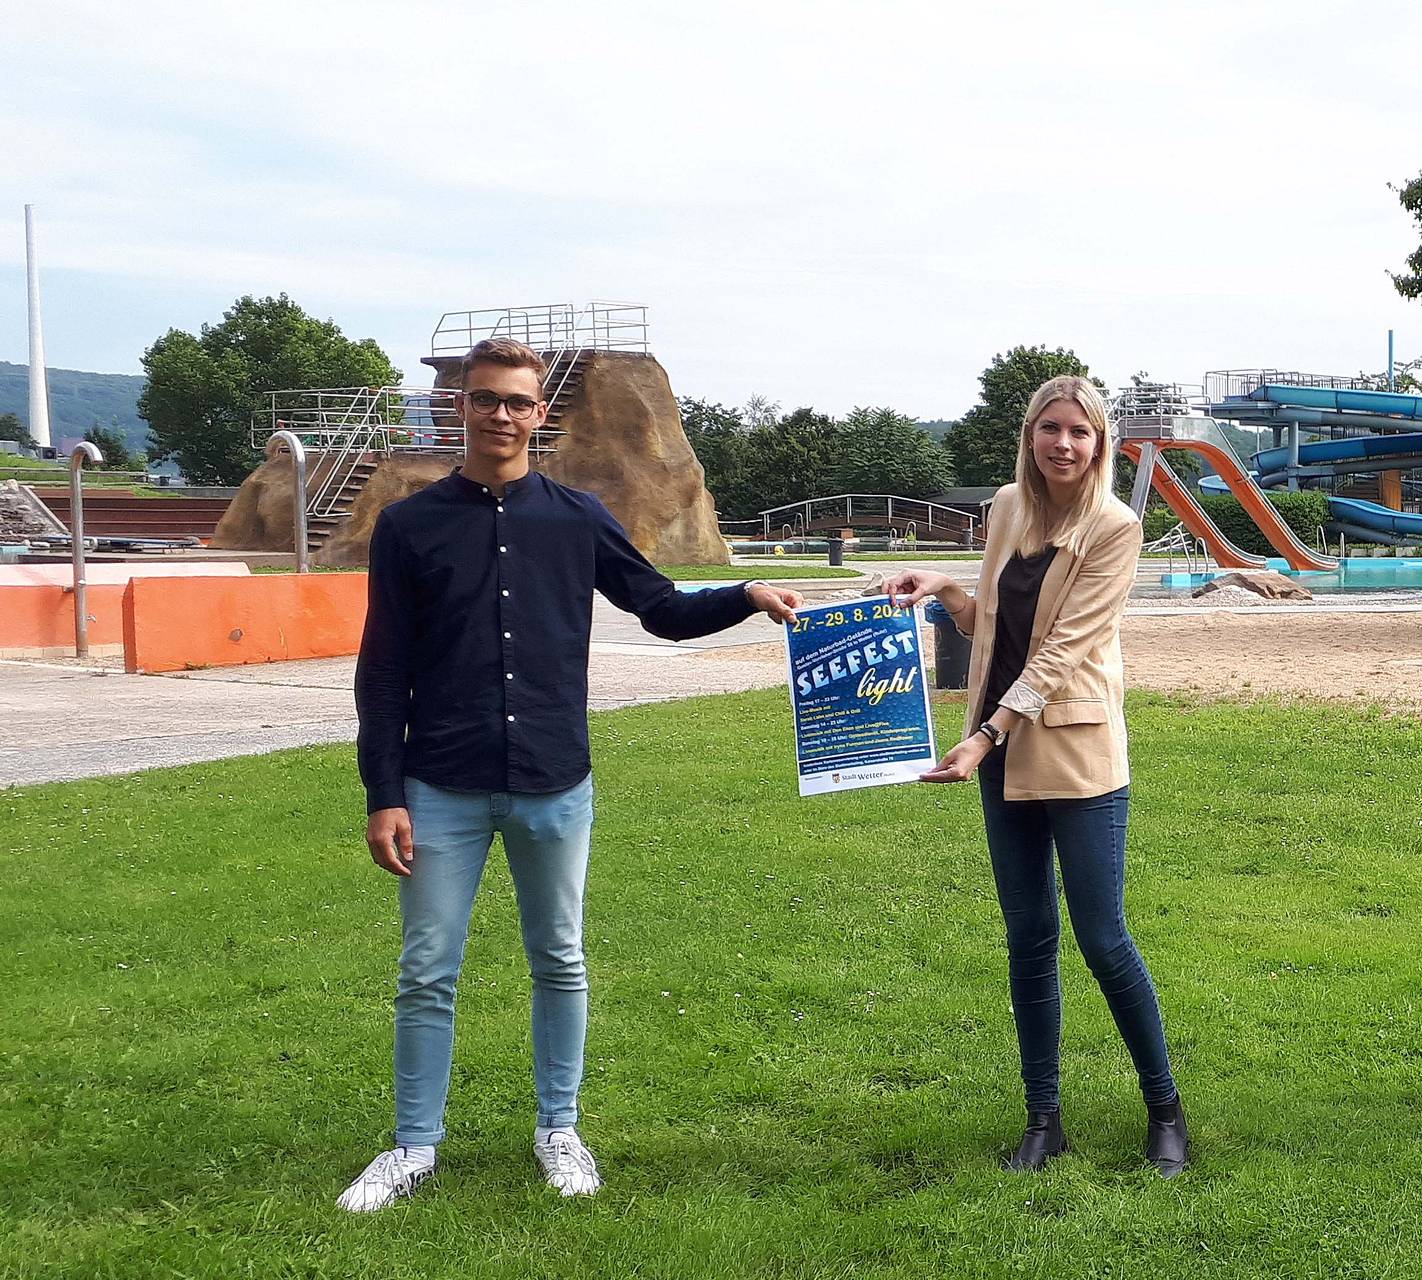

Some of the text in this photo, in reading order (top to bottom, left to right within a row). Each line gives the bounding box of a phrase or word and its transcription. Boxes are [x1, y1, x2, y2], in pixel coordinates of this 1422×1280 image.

[854, 608, 868, 622] 8.
[872, 603, 911, 620] 2021
[795, 656, 805, 666] auf
[806, 650, 818, 661] dem
[797, 629, 915, 697] SEEFEST
[856, 666, 918, 706] light
[857, 771, 884, 781] Wetter
